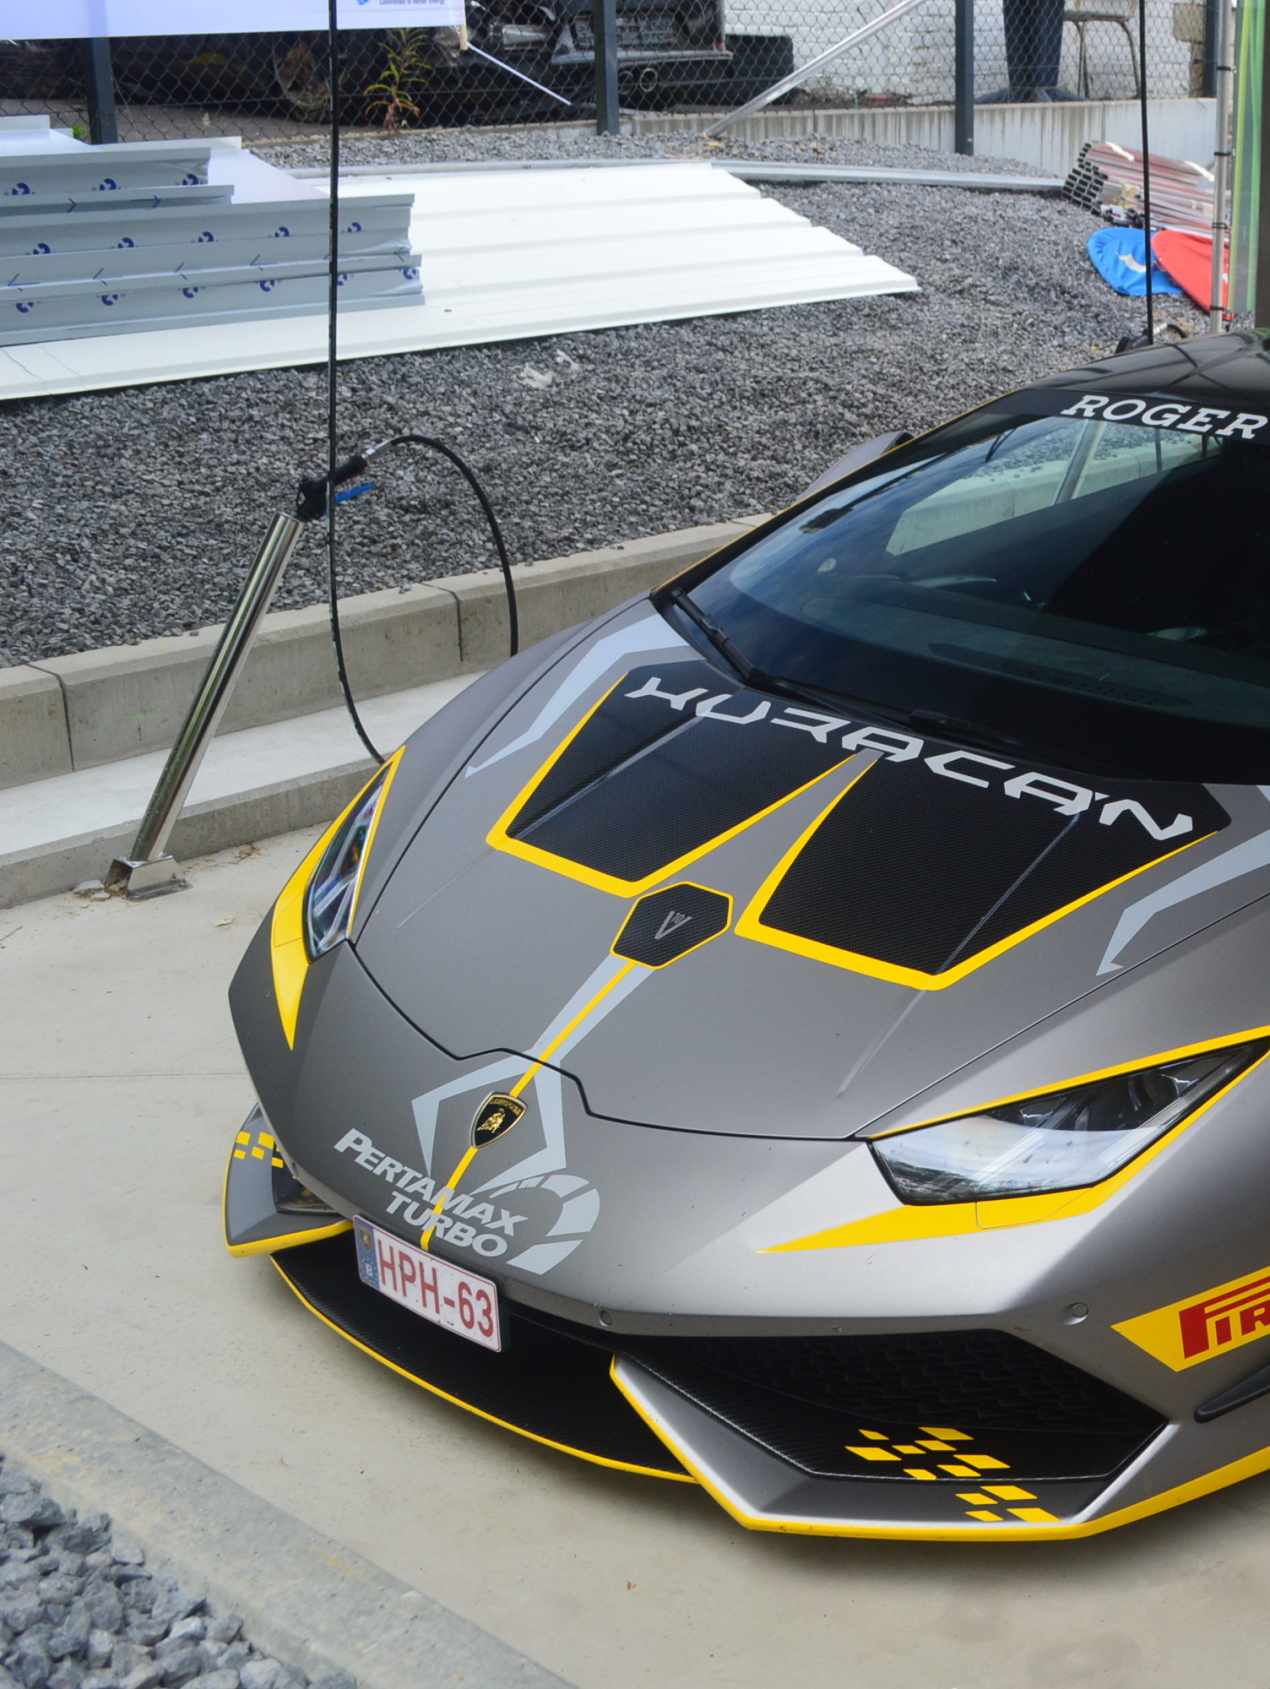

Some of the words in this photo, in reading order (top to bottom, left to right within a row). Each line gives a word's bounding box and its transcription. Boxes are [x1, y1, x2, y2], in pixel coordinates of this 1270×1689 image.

[1061, 394, 1268, 438] ROGER
[333, 1128, 528, 1236] PERTAMAX
[385, 1191, 508, 1257] TURBO
[377, 1238, 494, 1338] HPH-63
